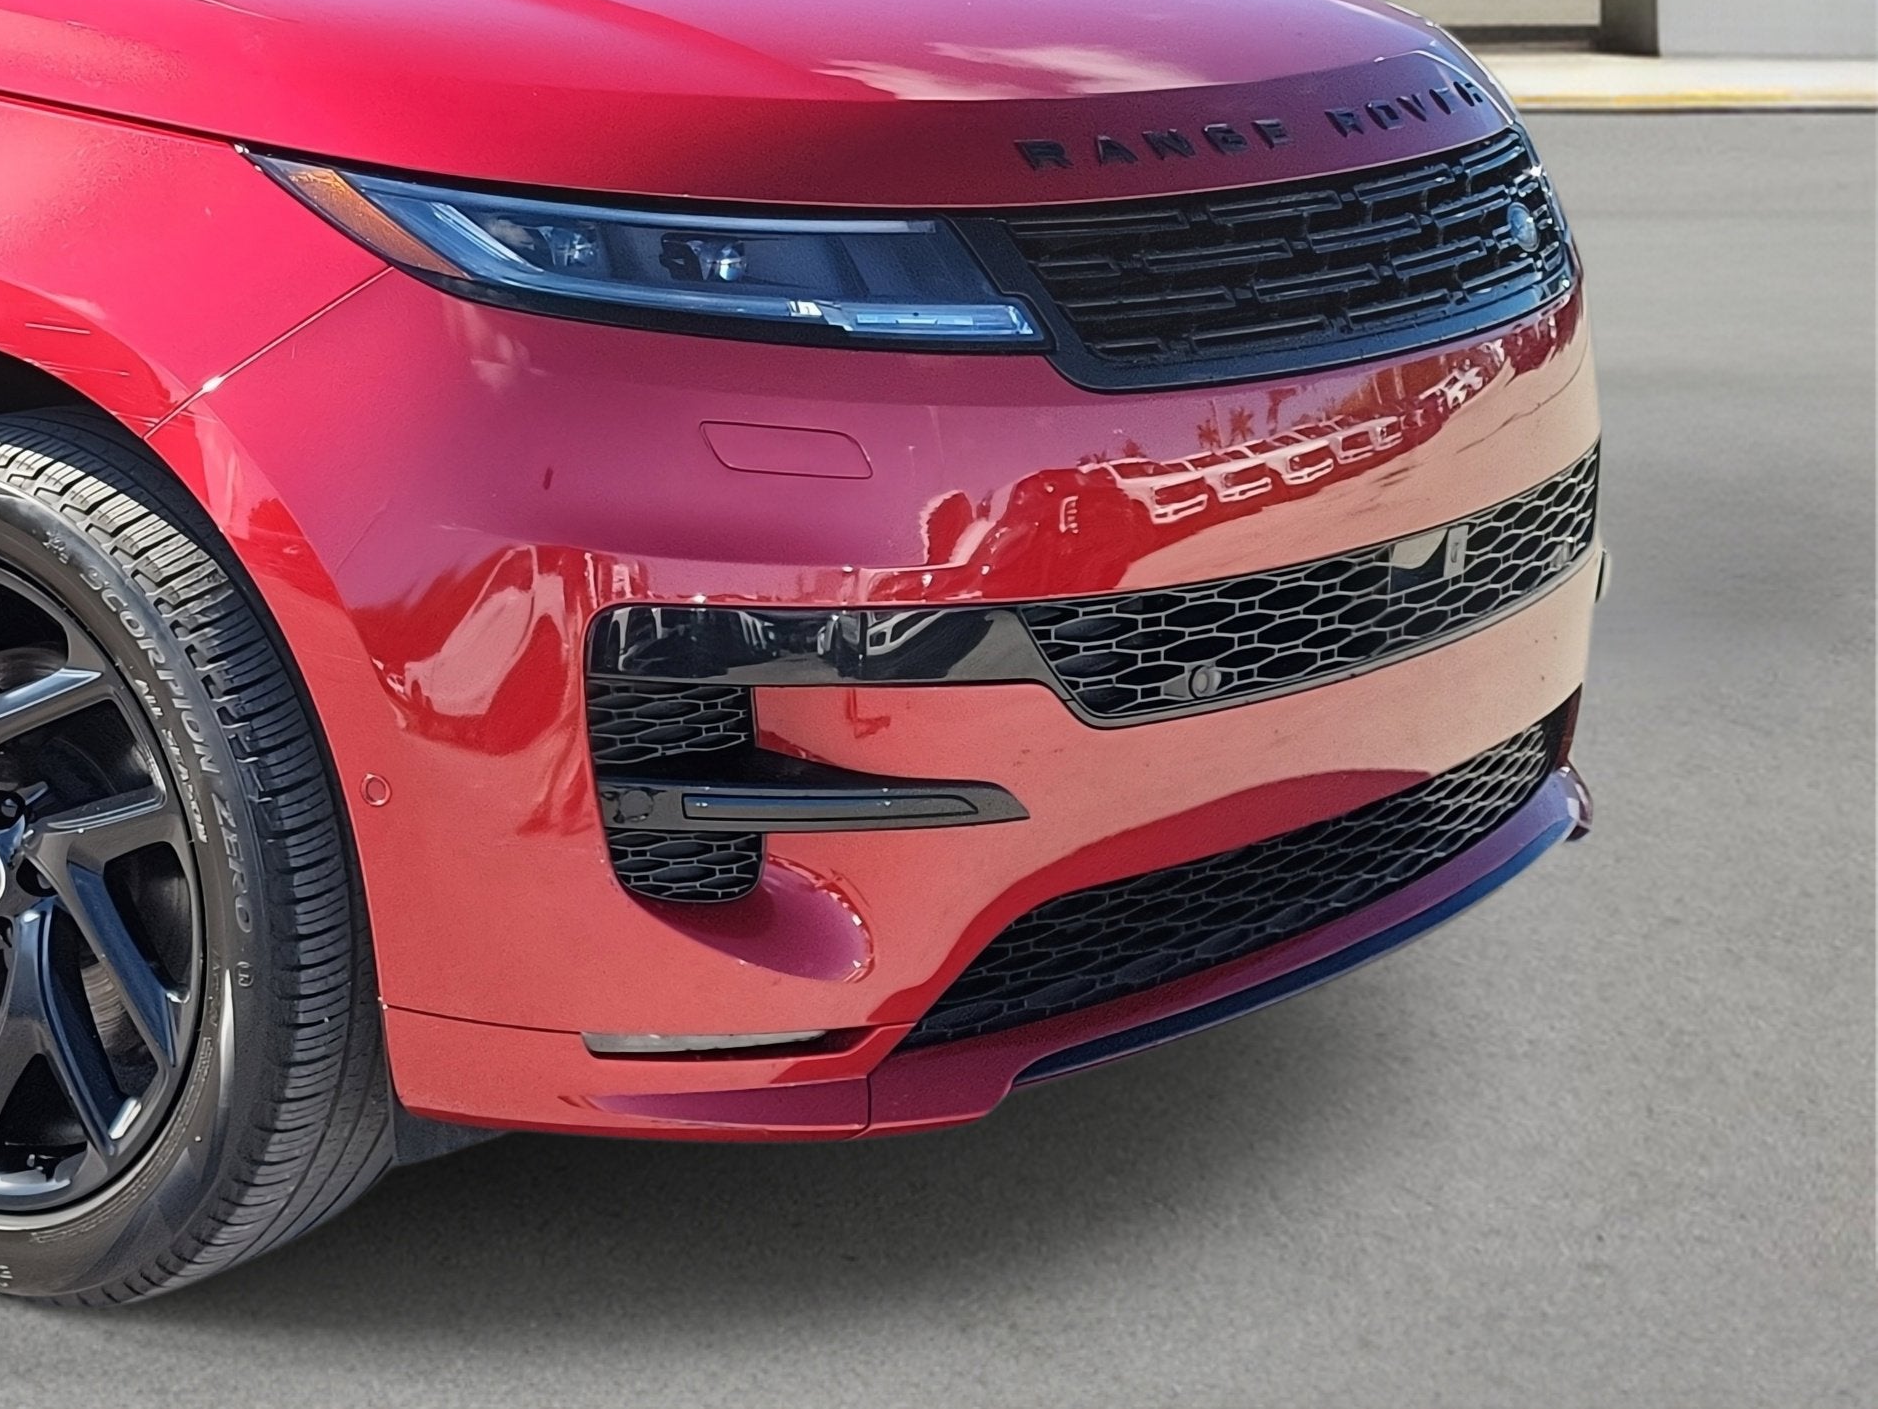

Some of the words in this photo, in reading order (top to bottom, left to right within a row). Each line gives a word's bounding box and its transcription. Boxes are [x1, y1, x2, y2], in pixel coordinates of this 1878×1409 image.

[1014, 118, 1293, 171] RANGE
[1324, 80, 1484, 139] ROVER
[78, 565, 221, 775] SCORPION
